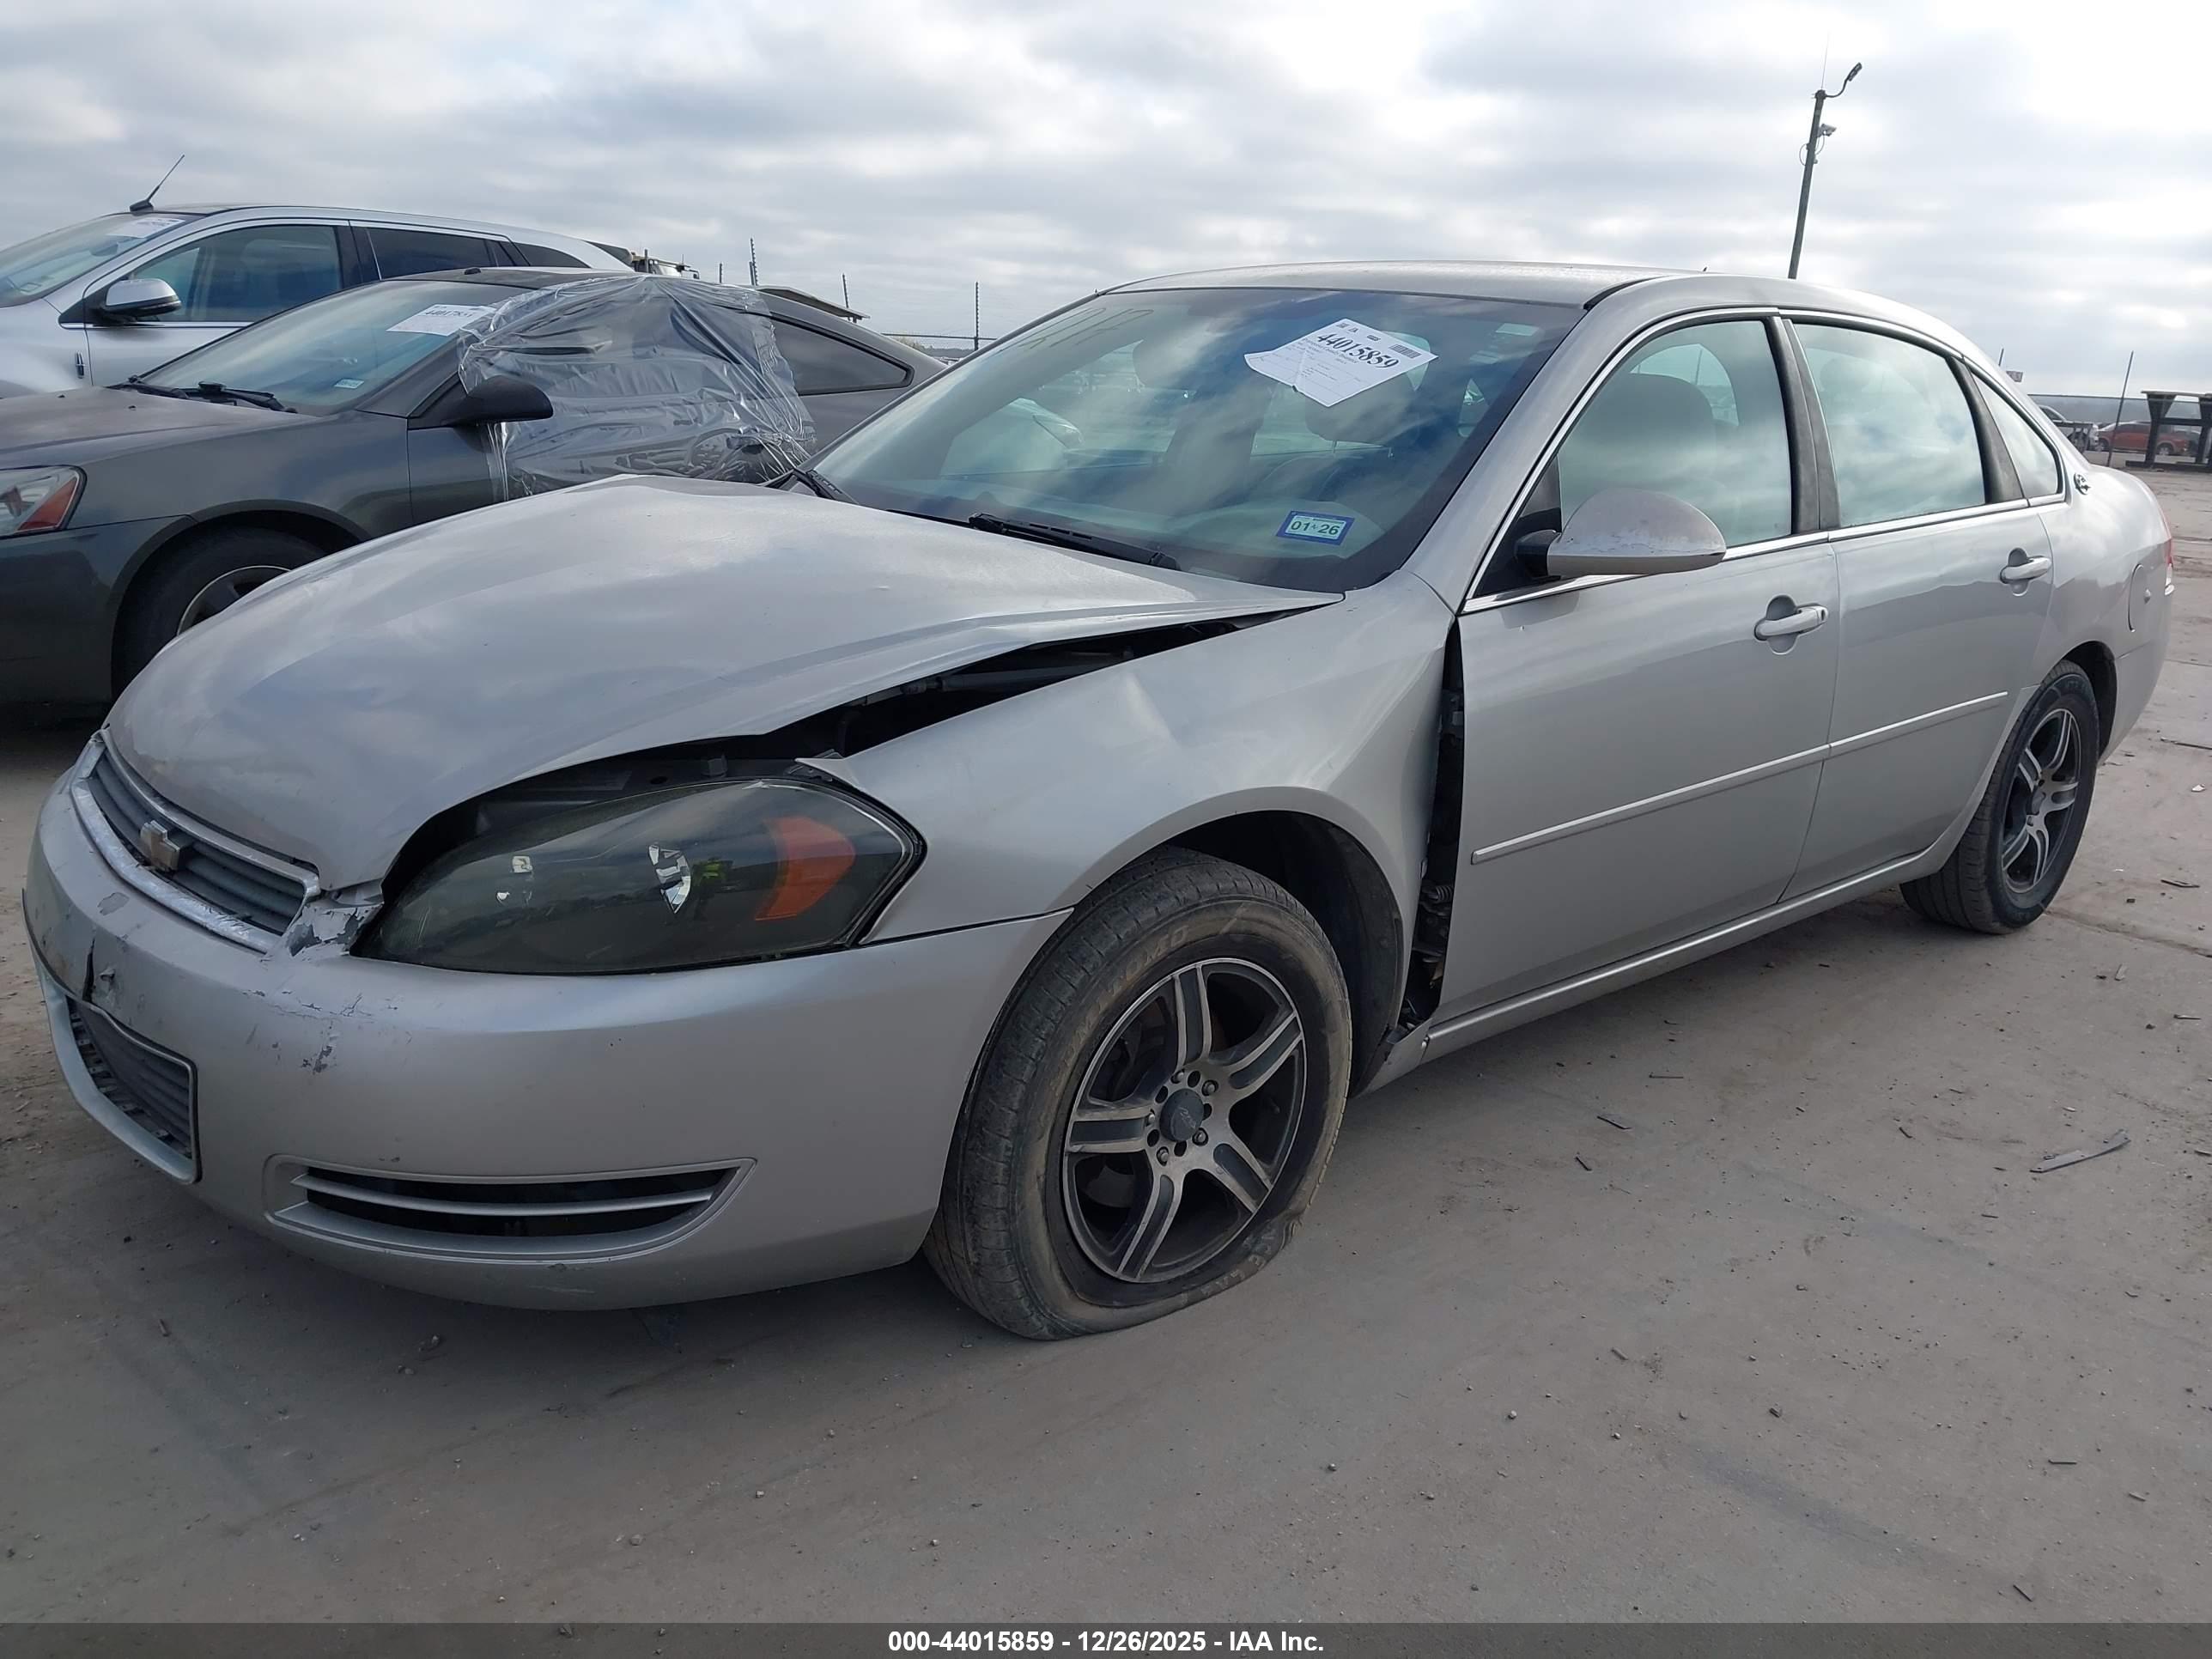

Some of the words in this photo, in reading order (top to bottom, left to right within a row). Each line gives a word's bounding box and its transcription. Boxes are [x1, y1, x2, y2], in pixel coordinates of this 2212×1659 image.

[1317, 333, 1400, 368] 44015859
[1291, 520, 1310, 532] 01
[1318, 524, 1340, 535] 26
